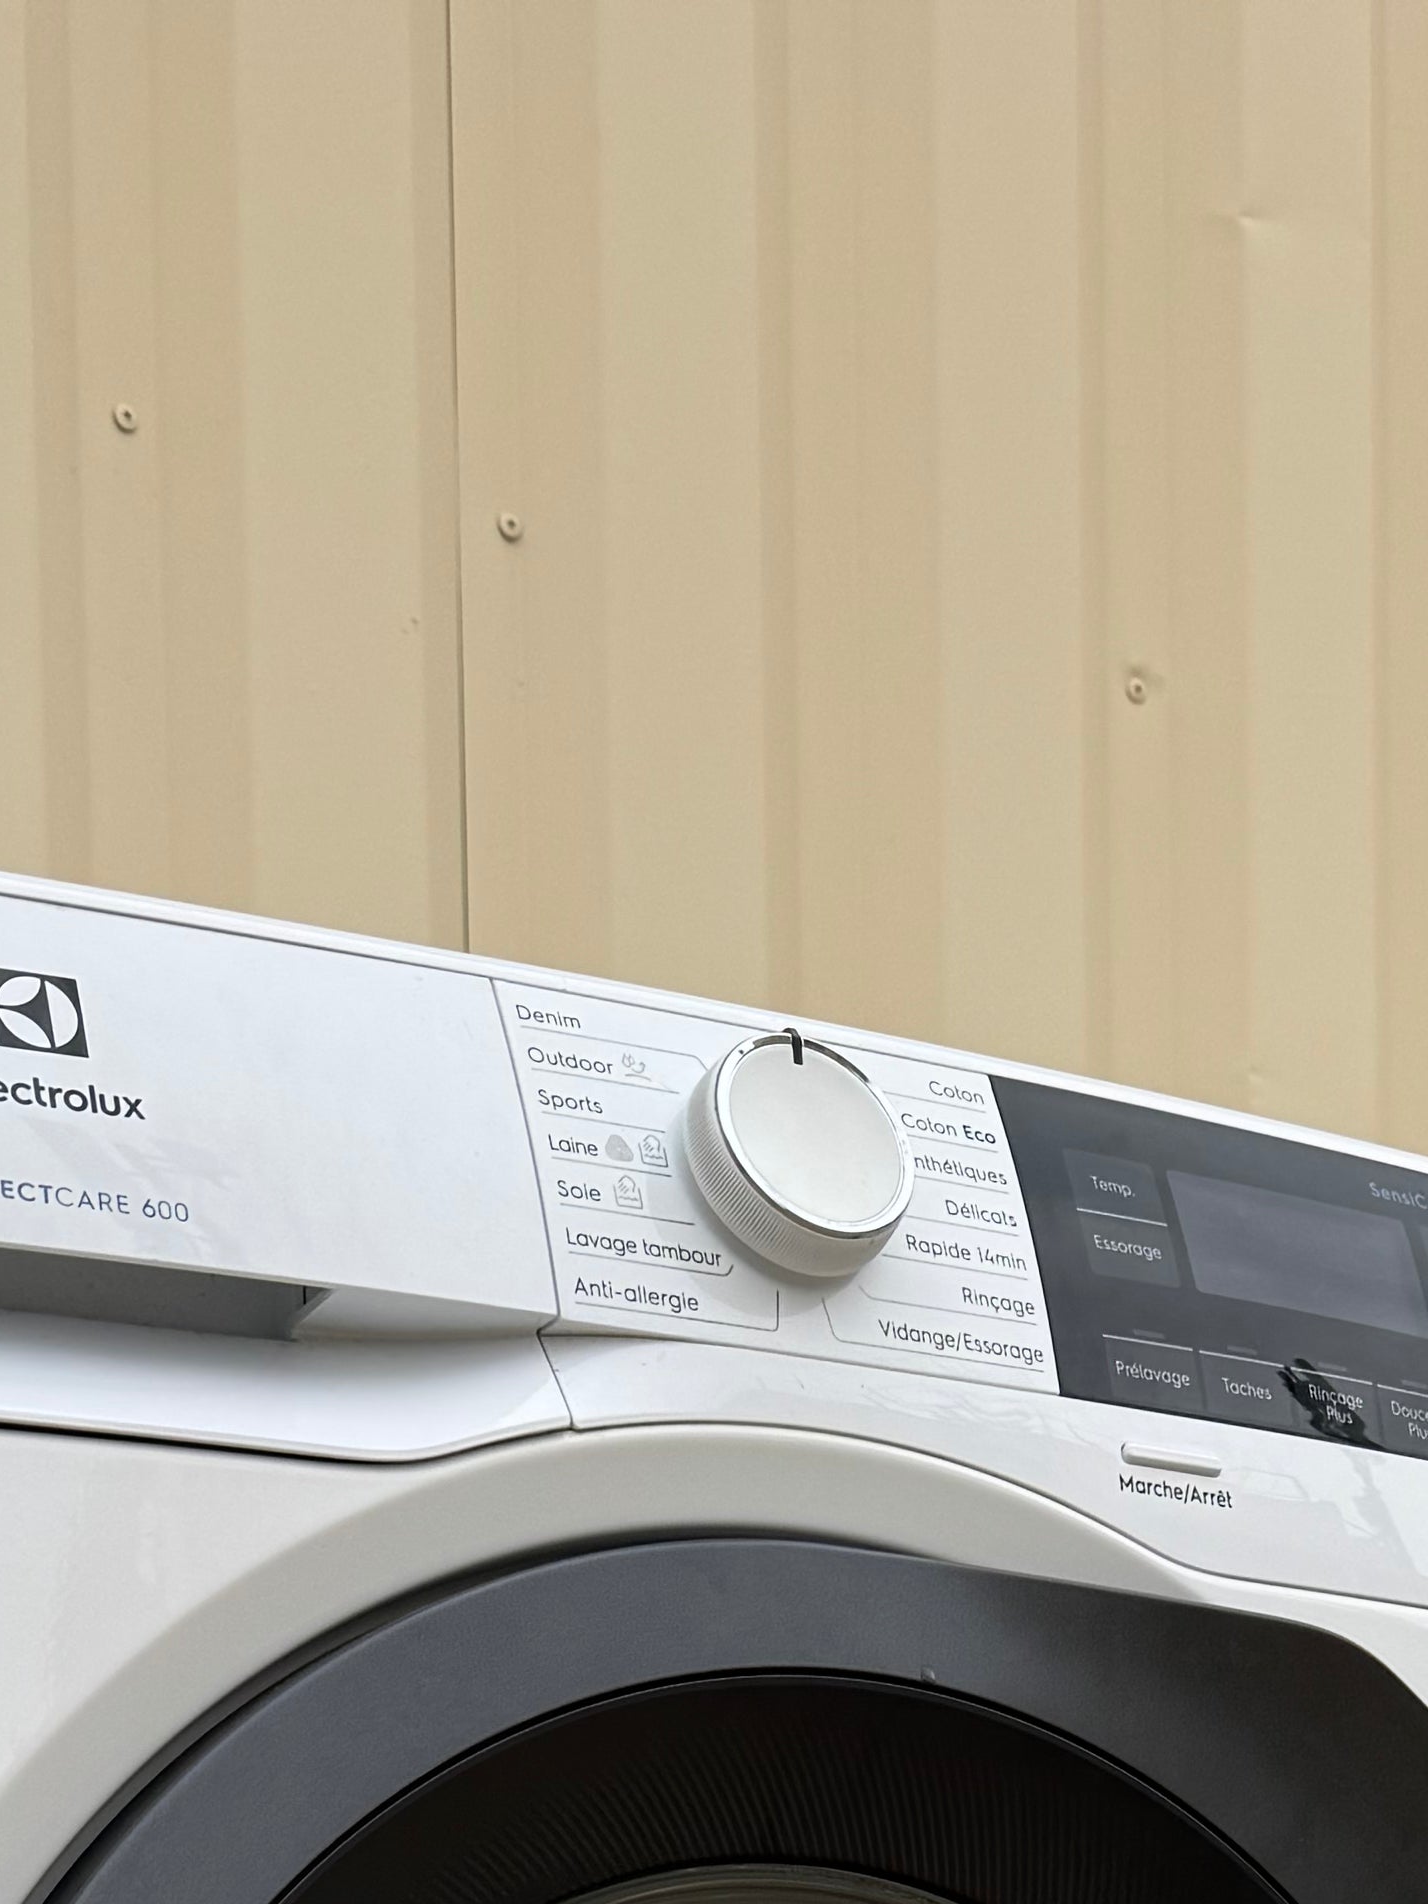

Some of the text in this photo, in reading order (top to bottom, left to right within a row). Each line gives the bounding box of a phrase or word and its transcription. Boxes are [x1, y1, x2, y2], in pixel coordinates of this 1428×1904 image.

[516, 1003, 582, 1030] Denim
[527, 1046, 614, 1075] Outdoor
[537, 1088, 604, 1115] Sports
[928, 1080, 985, 1106] Coton
[900, 1112, 997, 1145] Coton Eco
[548, 1133, 599, 1157] Laine
[556, 1179, 602, 1202] Soie
[1089, 1174, 1137, 1199] Temp.
[141, 1198, 190, 1224] 600
[945, 1198, 1018, 1228] Délicats
[566, 1226, 722, 1268] Lavage tambour
[905, 1233, 1028, 1272] Rapide 14min
[1093, 1233, 1163, 1262] Essorage
[574, 1276, 700, 1314] Anti-allergie
[961, 1286, 1036, 1318] Rinçage
[877, 1318, 1045, 1366] Vidange/Essorage
[1114, 1359, 1191, 1389] Prélavage
[1221, 1376, 1273, 1401] Taches
[1308, 1383, 1364, 1411] Rinçage
[1325, 1404, 1354, 1425] Plus
[1118, 1473, 1233, 1509] Marche/Arrêt
